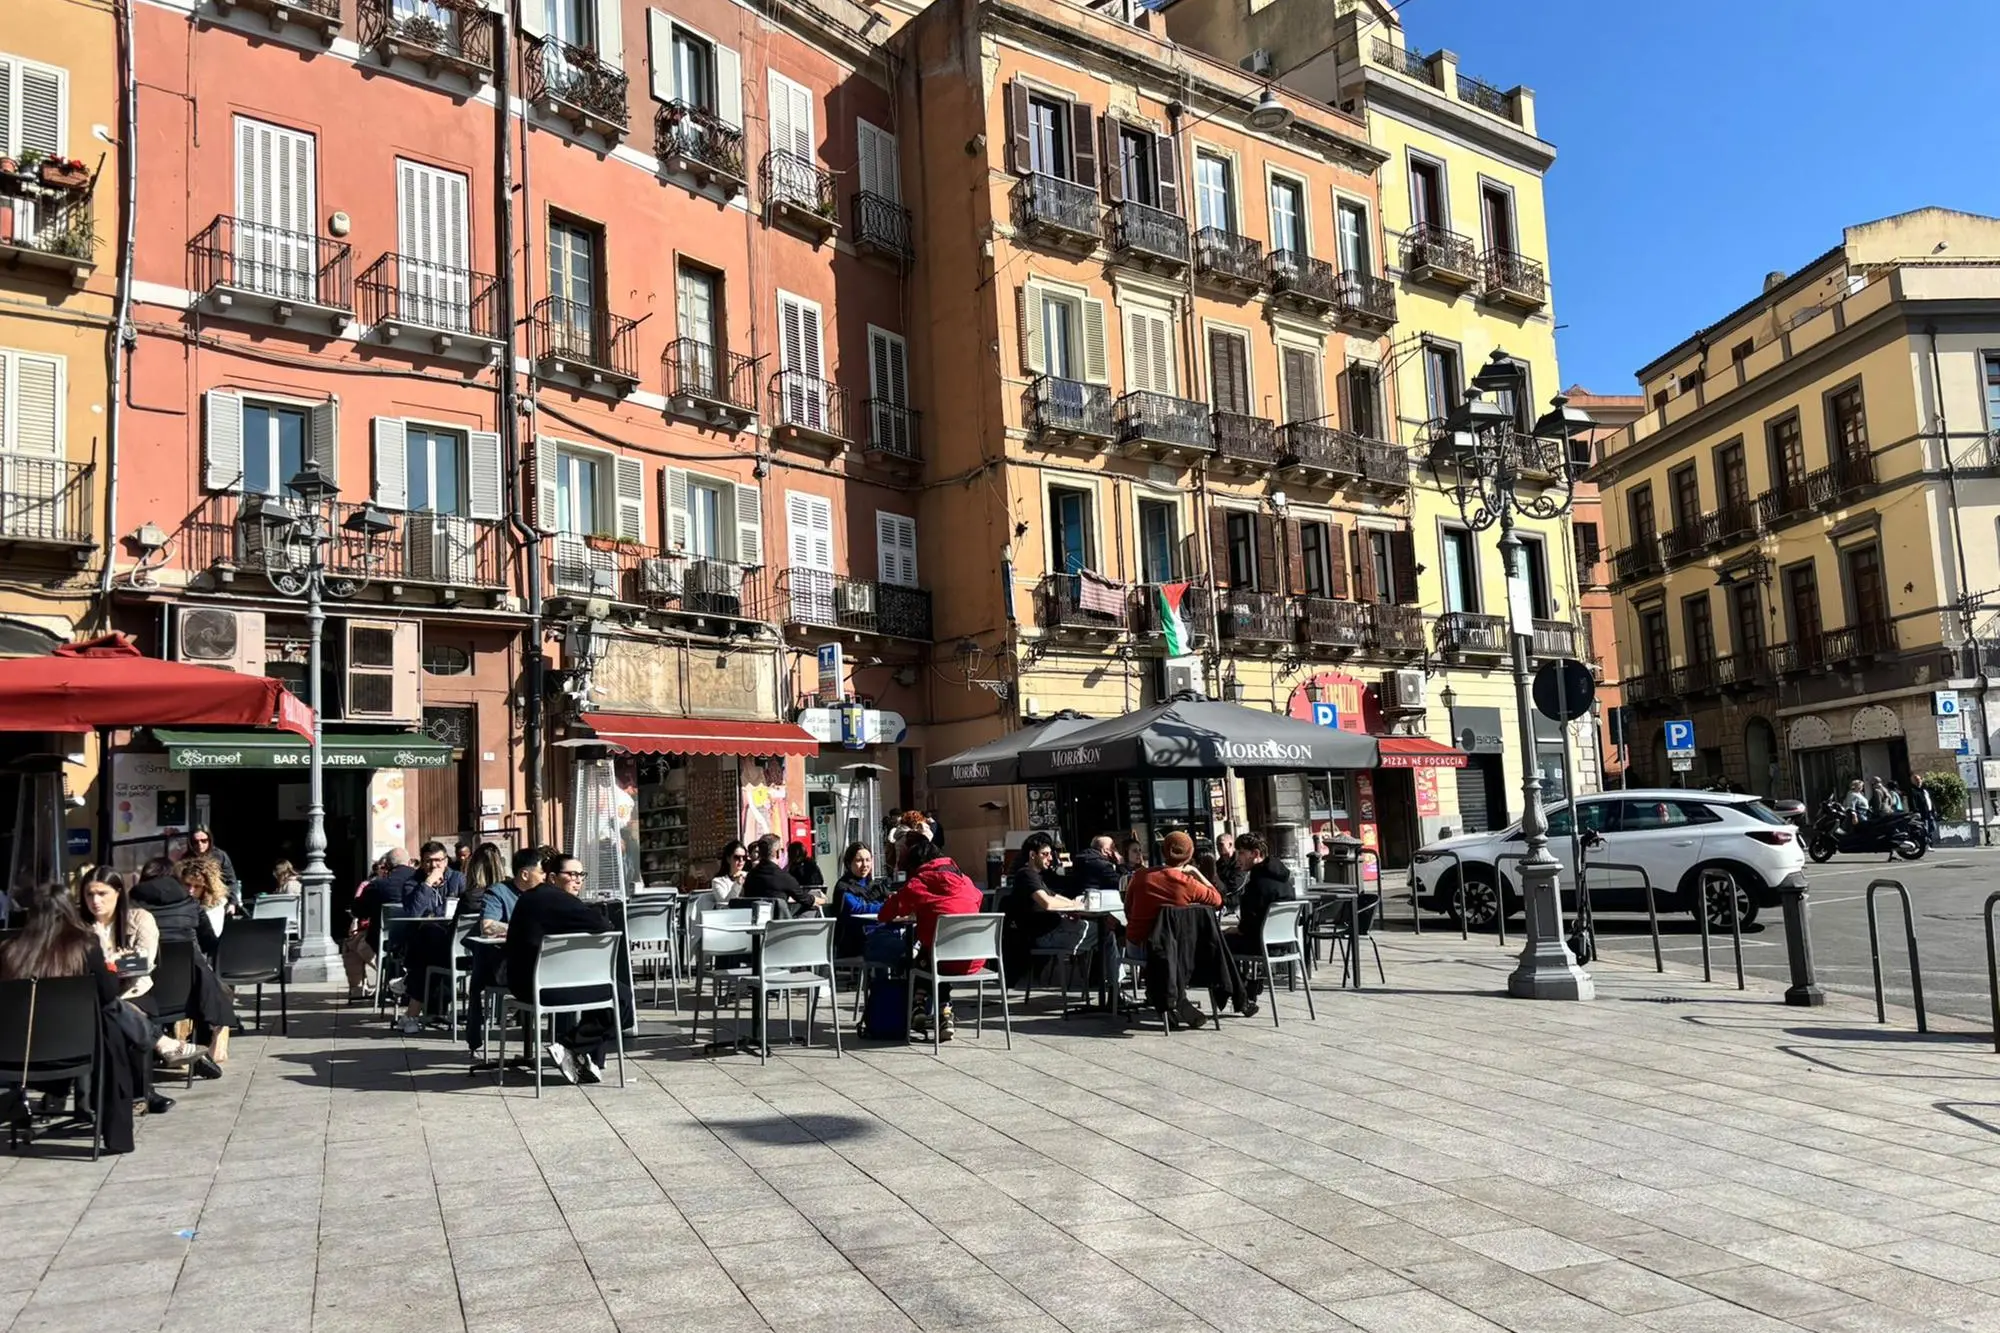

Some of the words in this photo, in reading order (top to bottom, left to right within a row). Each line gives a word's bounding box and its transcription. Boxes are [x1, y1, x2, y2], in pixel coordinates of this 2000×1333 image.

[1318, 706, 1333, 725] P
[1671, 724, 1687, 746] P
[1050, 747, 1101, 767] MORRISON
[1215, 739, 1312, 759] MORRISON
[273, 754, 298, 764] BAR
[302, 754, 367, 765] GLATERIA
[1382, 756, 1407, 765] PIZZA
[1425, 757, 1464, 765] FOCACCIA
[951, 762, 991, 780] MORRISON
